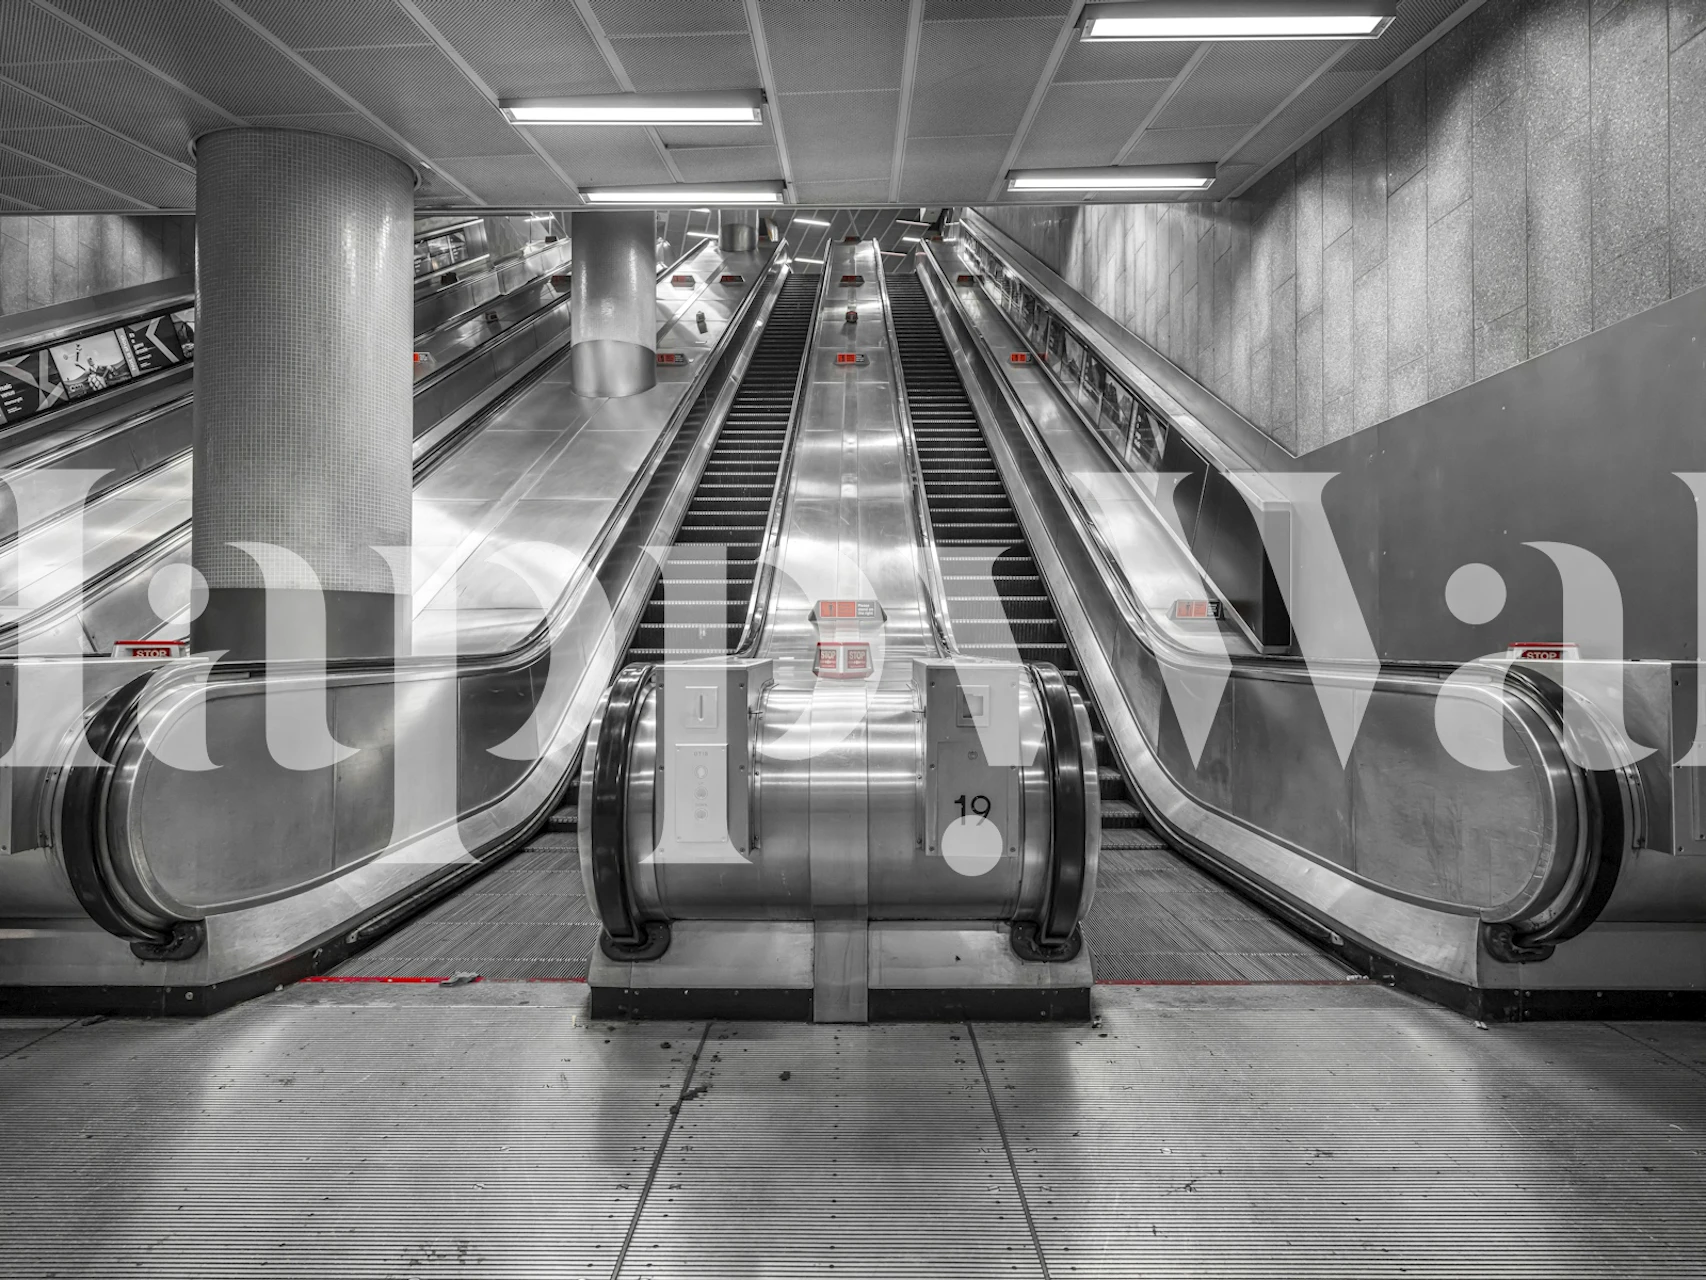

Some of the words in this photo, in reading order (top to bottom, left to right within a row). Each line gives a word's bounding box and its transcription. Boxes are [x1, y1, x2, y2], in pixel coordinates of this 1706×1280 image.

[136, 650, 167, 658] STOP
[820, 650, 836, 660] STOP
[849, 650, 866, 660] STOP
[1526, 651, 1557, 659] STOP
[954, 794, 991, 827] 19
